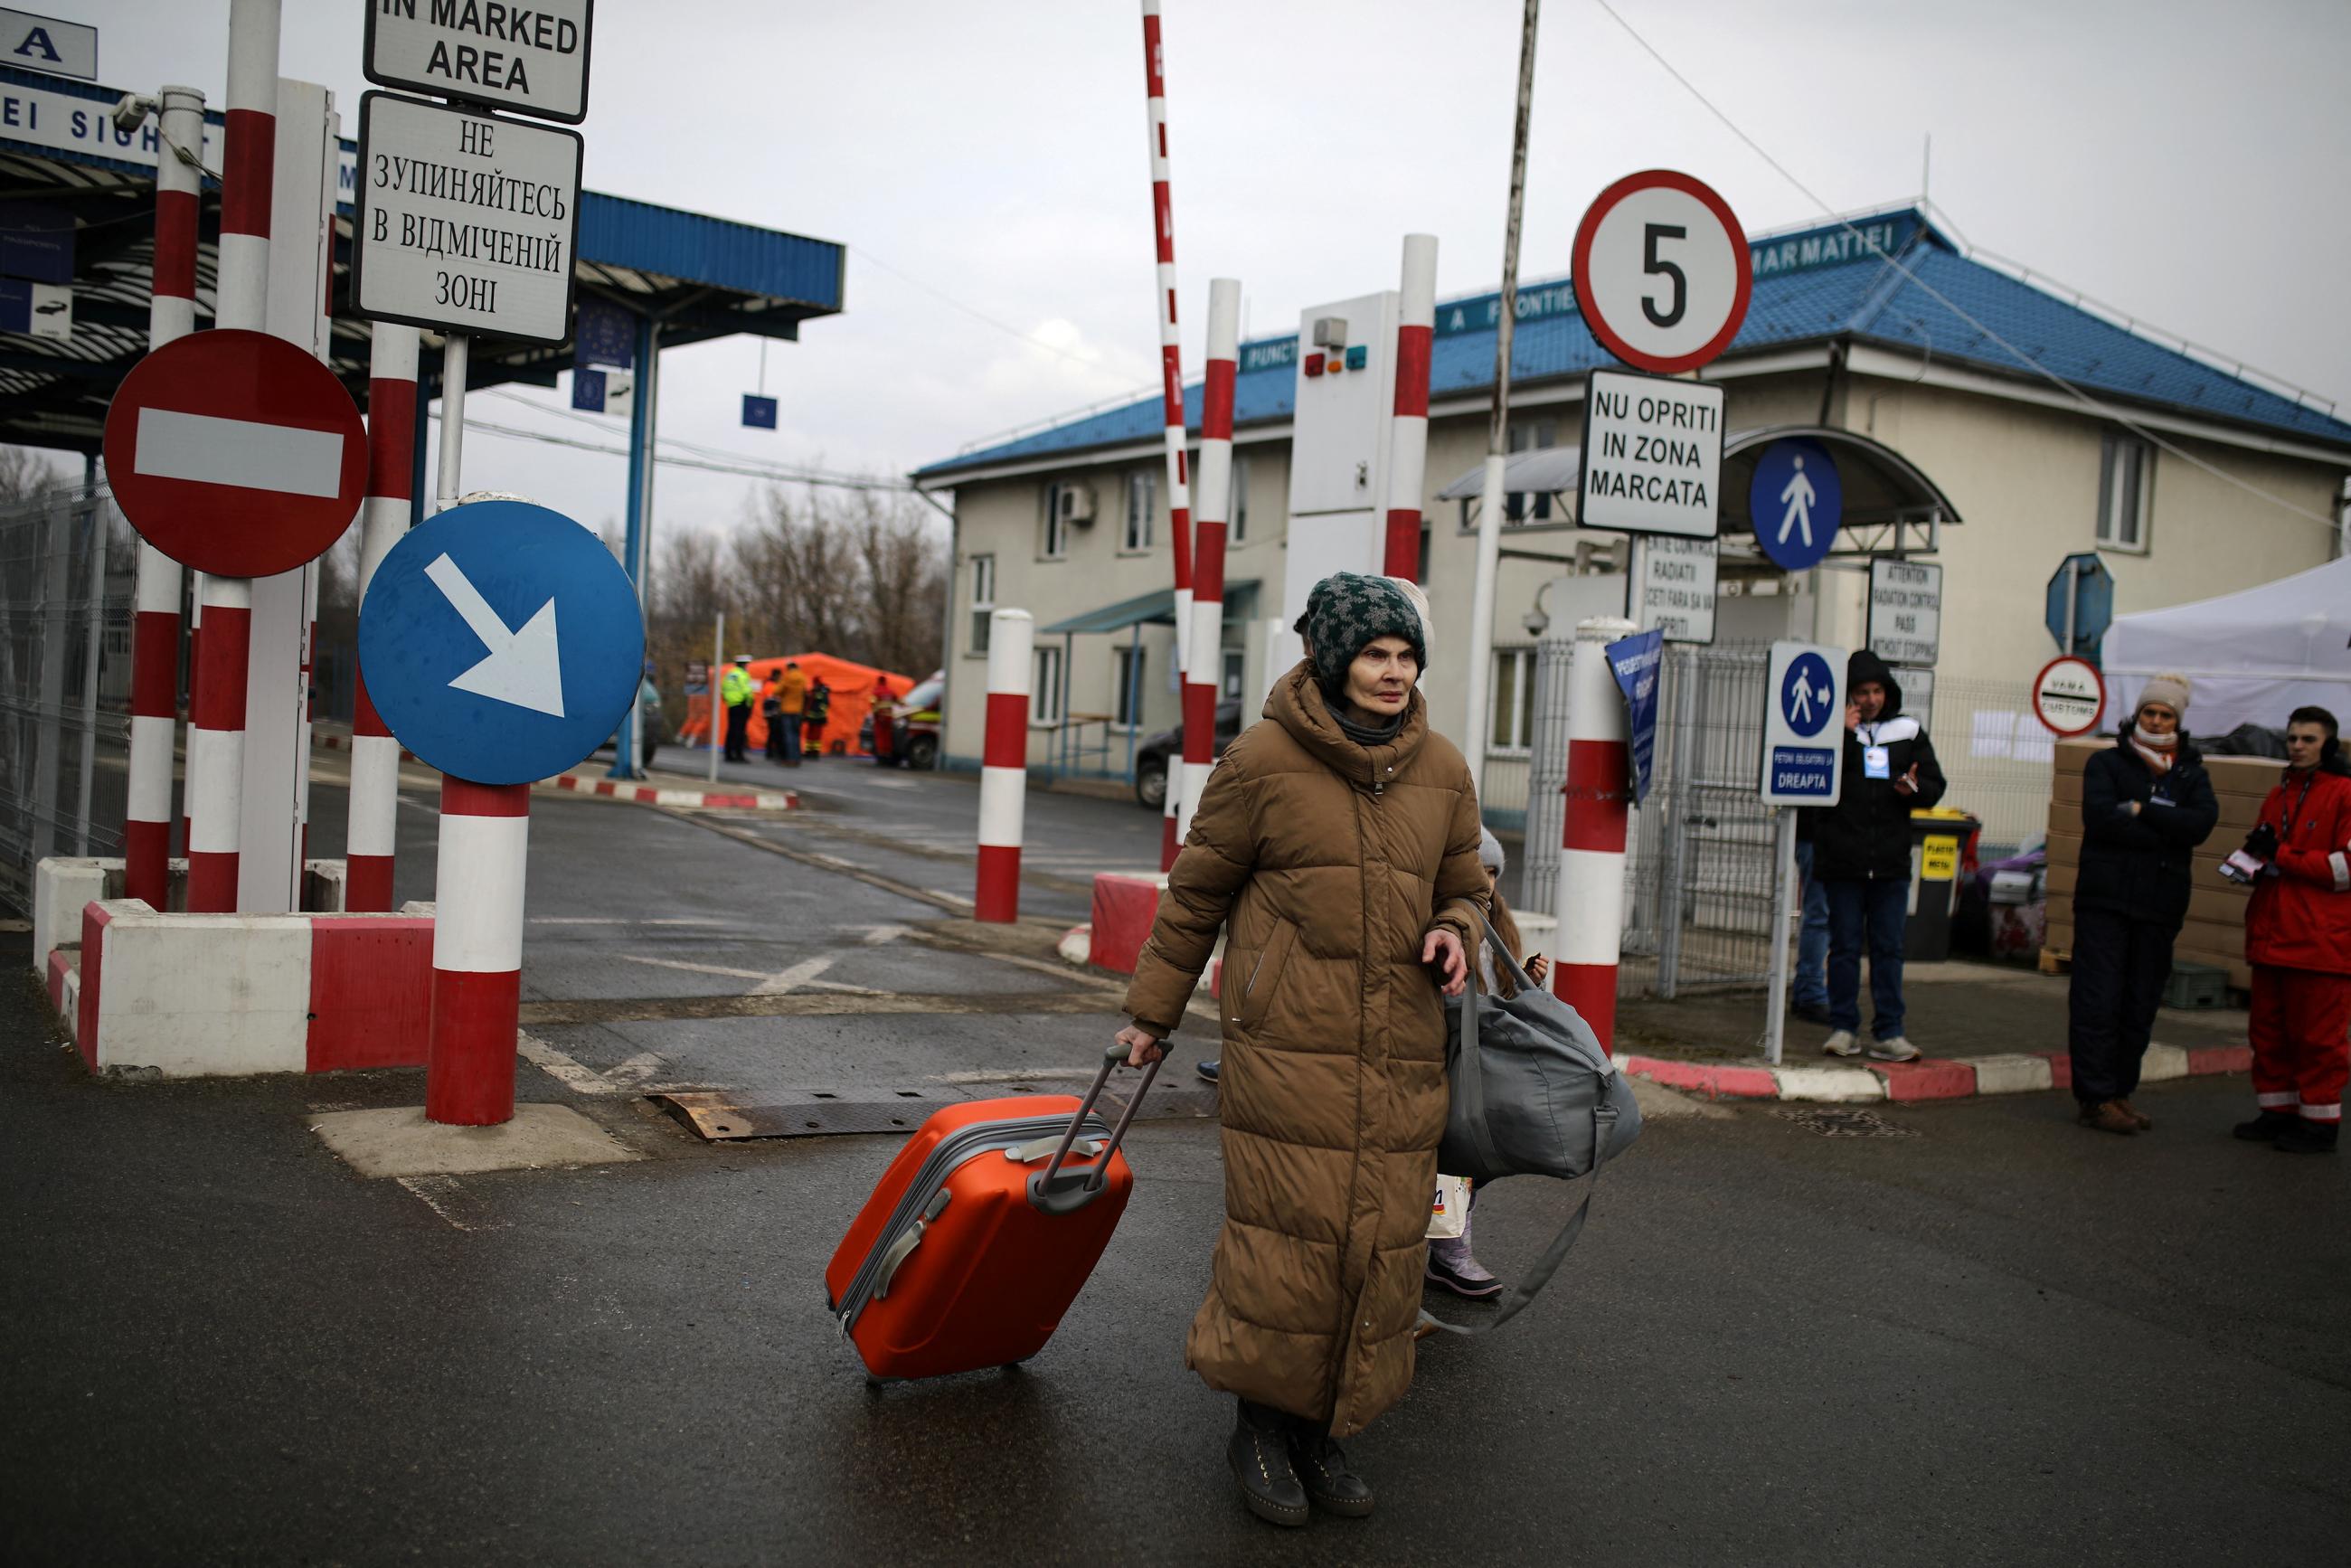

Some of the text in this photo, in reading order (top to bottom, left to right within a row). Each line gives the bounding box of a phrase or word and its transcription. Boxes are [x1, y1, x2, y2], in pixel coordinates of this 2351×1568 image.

[14, 26, 62, 62] A
[430, 0, 578, 54] MARKED
[426, 40, 530, 94] AREA
[459, 119, 495, 158] НЕ
[373, 153, 566, 221] ЗУПИНЯЙТЕСЬ
[373, 207, 562, 273] В ВІДМІЧЕНІЙ
[435, 270, 498, 314] ЗОНІ
[1641, 223, 1686, 327] 5
[1450, 308, 1466, 331] A
[1487, 286, 1579, 324] FONTIE
[1595, 391, 1716, 433] NU OPRITI
[1603, 430, 1701, 468] IN ZONA
[1591, 469, 1708, 508] MARCATA
[1887, 565, 1930, 585] ATTENTION
[1874, 588, 1940, 612] RADIATION CONTROL
[1895, 614, 1916, 634] PASS
[2053, 679, 2084, 692] VAMA
[1778, 771, 1827, 789] DREAPTA
